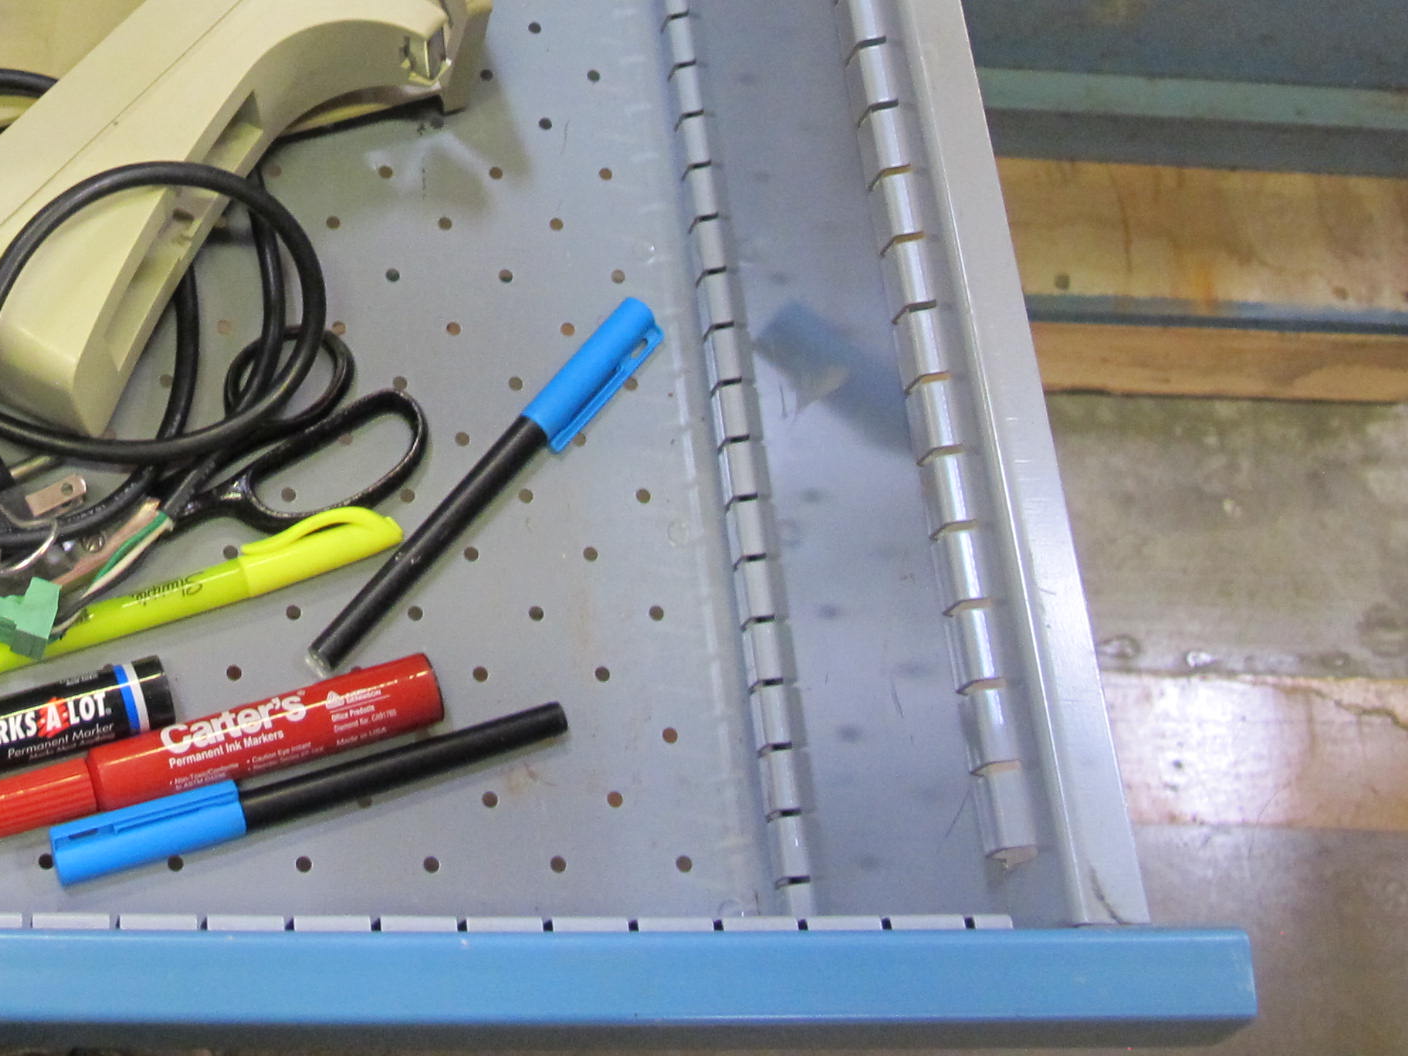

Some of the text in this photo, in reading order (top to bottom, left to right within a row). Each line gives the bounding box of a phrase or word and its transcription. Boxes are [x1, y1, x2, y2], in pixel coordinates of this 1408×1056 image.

[7, 723, 115, 760] Permanent Marker
[160, 694, 307, 755] Carter's
[168, 747, 225, 769] Permanent
[226, 741, 243, 754] Ink
[243, 729, 286, 749] Markers
